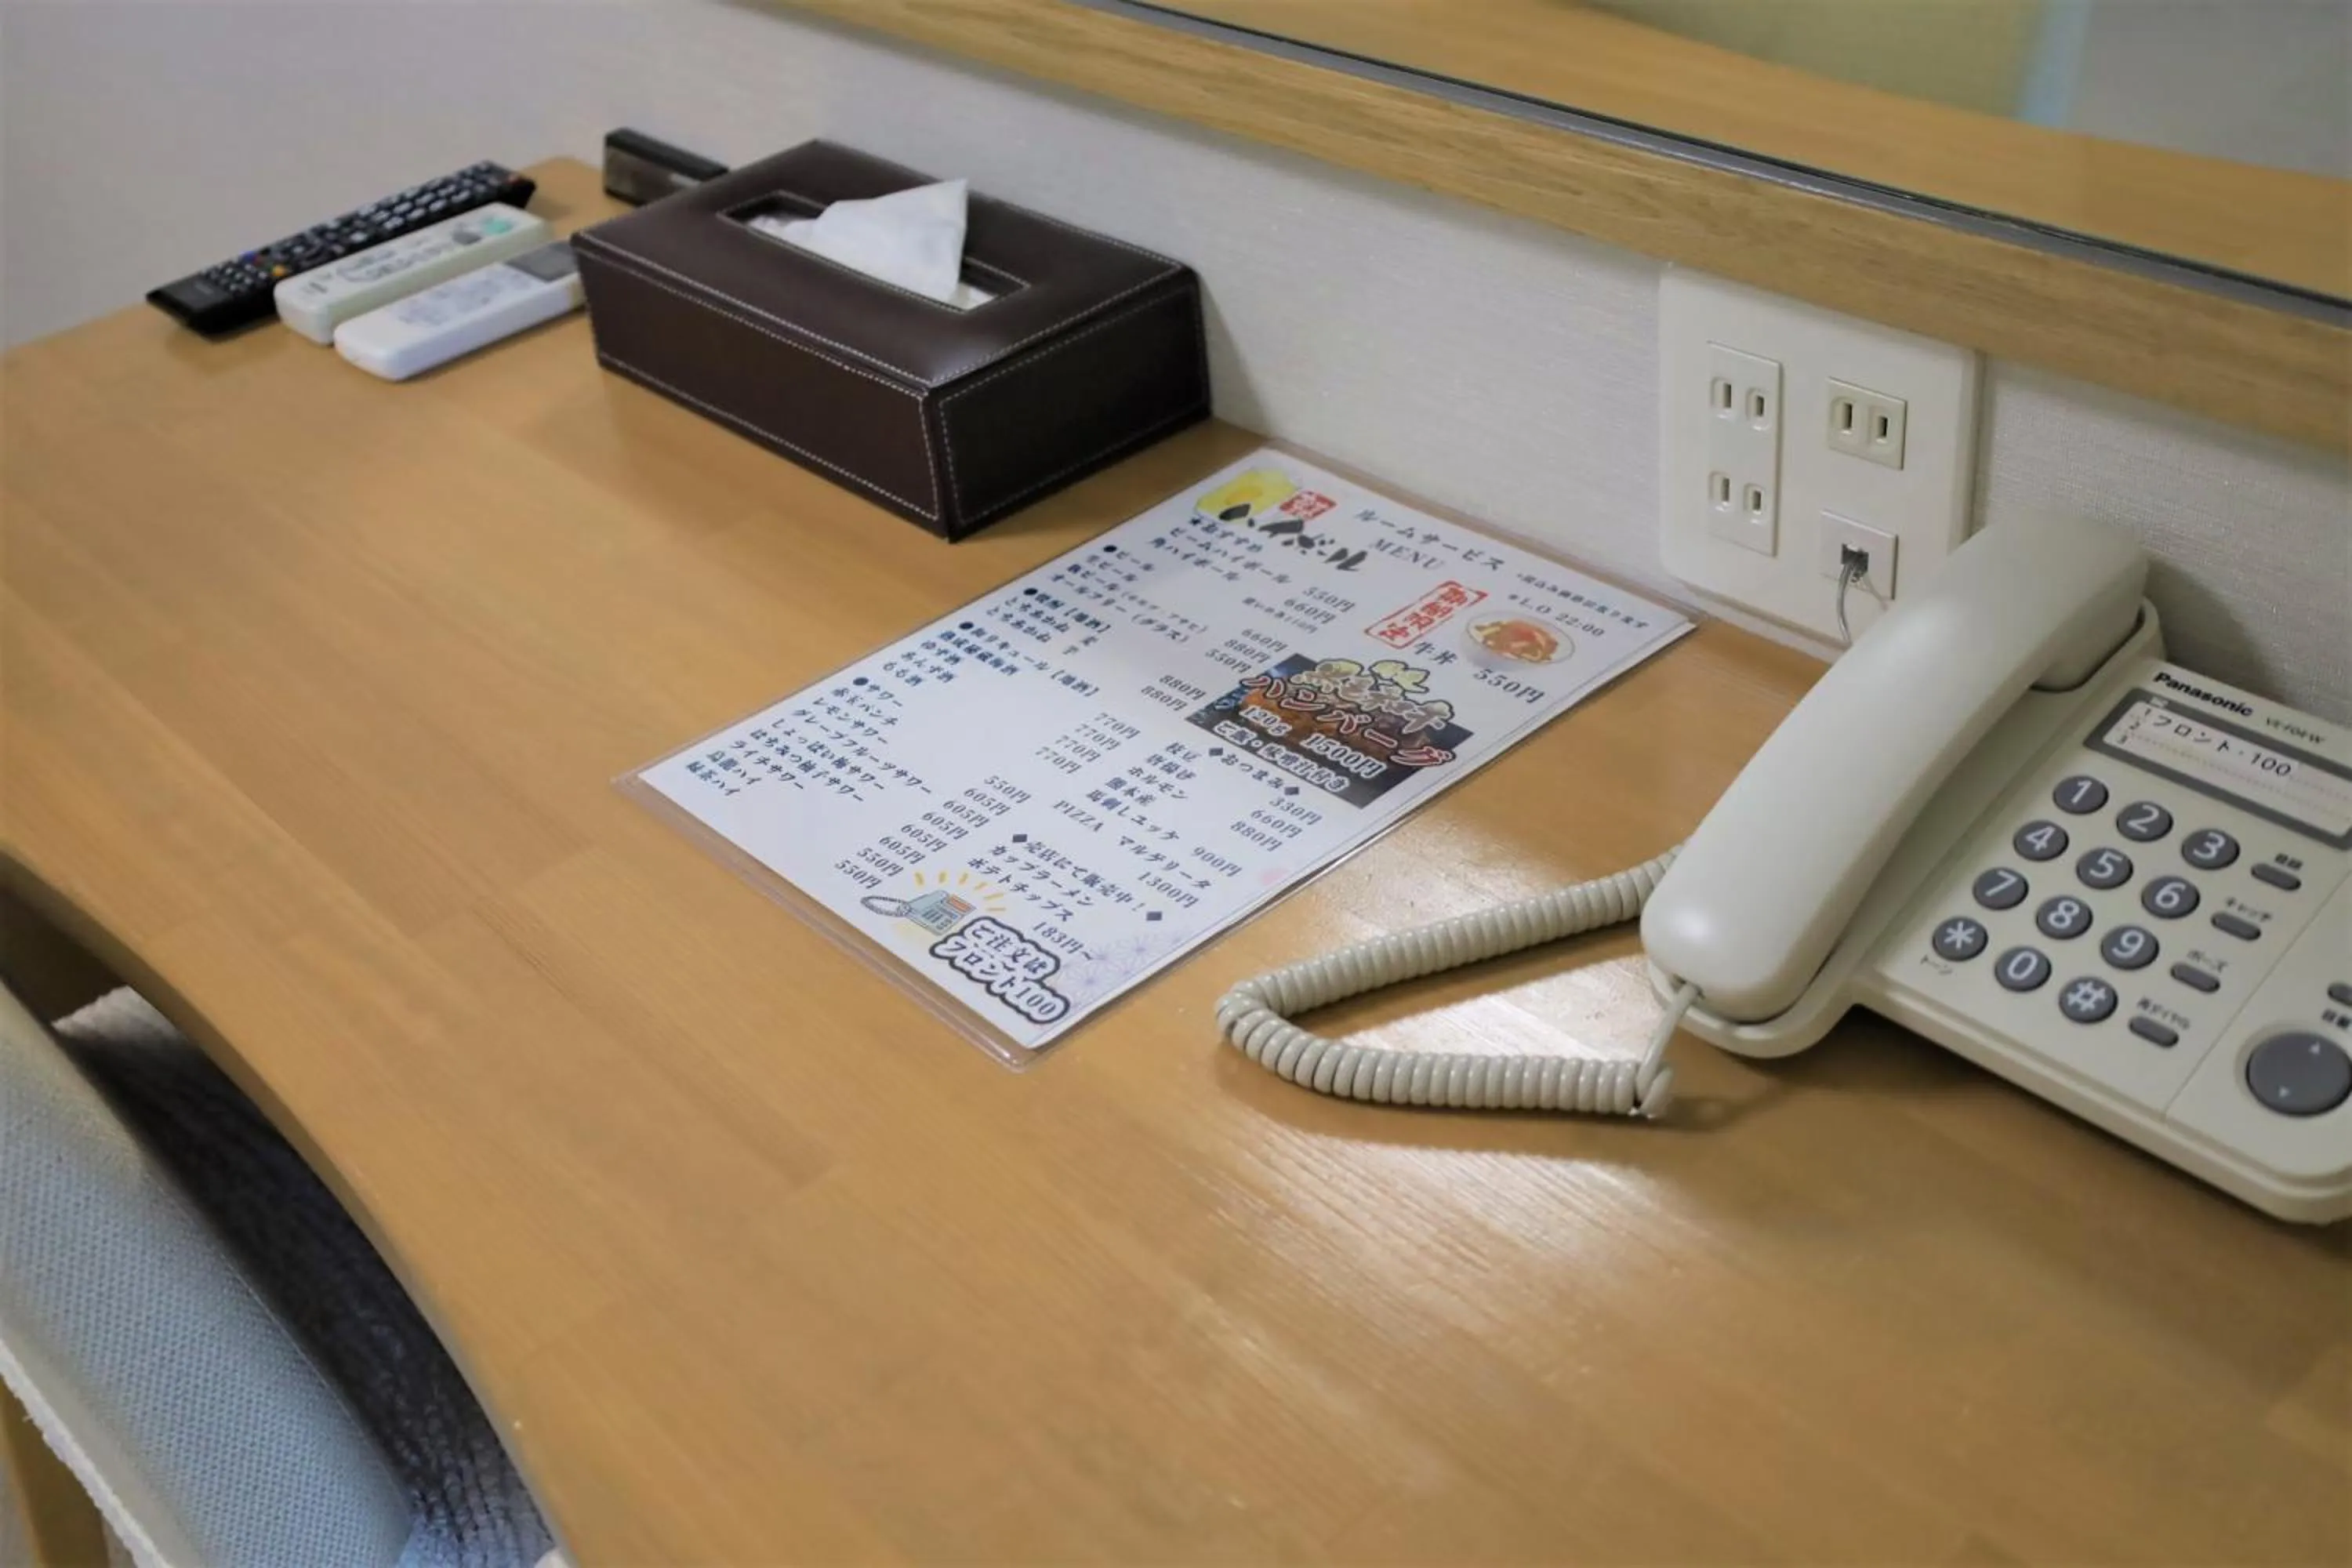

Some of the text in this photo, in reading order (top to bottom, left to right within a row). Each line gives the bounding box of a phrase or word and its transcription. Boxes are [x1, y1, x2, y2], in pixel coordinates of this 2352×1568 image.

[1200, 520, 1263, 553] おすすめ
[1219, 503, 1367, 572] ハイボール
[1356, 510, 1505, 572] ルームサービス
[1374, 538, 1444, 569] MENU
[1115, 550, 1155, 572] ビール
[1148, 536, 1337, 625] 角ハイボール 660円
[1169, 526, 1356, 613] ビームハイボール 550円
[1086, 554, 1289, 653] 生ビール 660円
[1555, 613, 1606, 637] 22:00
[1205, 648, 1252, 674] 550円
[1224, 639, 1271, 664] 880円
[1414, 641, 1545, 704] 牛丼 550円
[866, 684, 903, 707] サワー
[901, 652, 1102, 763] あんず酒 770円
[920, 641, 1121, 751] ゆず酒 770円
[1141, 685, 1189, 712] 880円
[1159, 674, 1207, 701] 880円
[2154, 672, 2253, 717] Panasonic
[882, 662, 1083, 775] もも酒 770円
[1094, 712, 1142, 740] 770円
[1240, 676, 1455, 766] ハンバーグ
[811, 697, 1011, 816] レモンサワー 605円
[1241, 706, 1388, 779] 120g 1500円
[750, 728, 949, 853] はちみつ柚子サワー 605円
[771, 718, 970, 840] しょっぱい梅サワー 605円
[792, 709, 990, 829] グレープフルーツサワー 605円
[984, 775, 1032, 804] 550円
[1165, 742, 1323, 826] 枝豆 330円
[1221, 753, 1284, 789] おつまみ
[731, 740, 926, 865] ライチサワー 605円
[1127, 766, 1283, 852] ホルモン 880円
[1146, 753, 1304, 839] 唐揚げ 660円
[2071, 780, 2092, 804] 1
[1085, 789, 1243, 877] 馬刺しユッケ 900円
[2025, 825, 2056, 851] 4
[2126, 804, 2160, 833] 2
[856, 847, 905, 877] 550円
[1053, 800, 1212, 890] PIZZA マルゲリータ
[2089, 851, 2123, 878] 5
[2193, 832, 2226, 859] 3
[834, 859, 883, 890] 550円
[967, 858, 1074, 923] ポテトチップス
[990, 845, 1094, 906] カップラーメン
[1137, 871, 1200, 909] 1300円
[1985, 869, 2018, 896] 7
[2155, 881, 2187, 909] 6
[2047, 899, 2080, 929] 8
[970, 927, 1049, 975] ご注文は
[2006, 949, 2038, 980] 0
[2112, 929, 2144, 958] 9
[941, 933, 1056, 1016] フロント100
